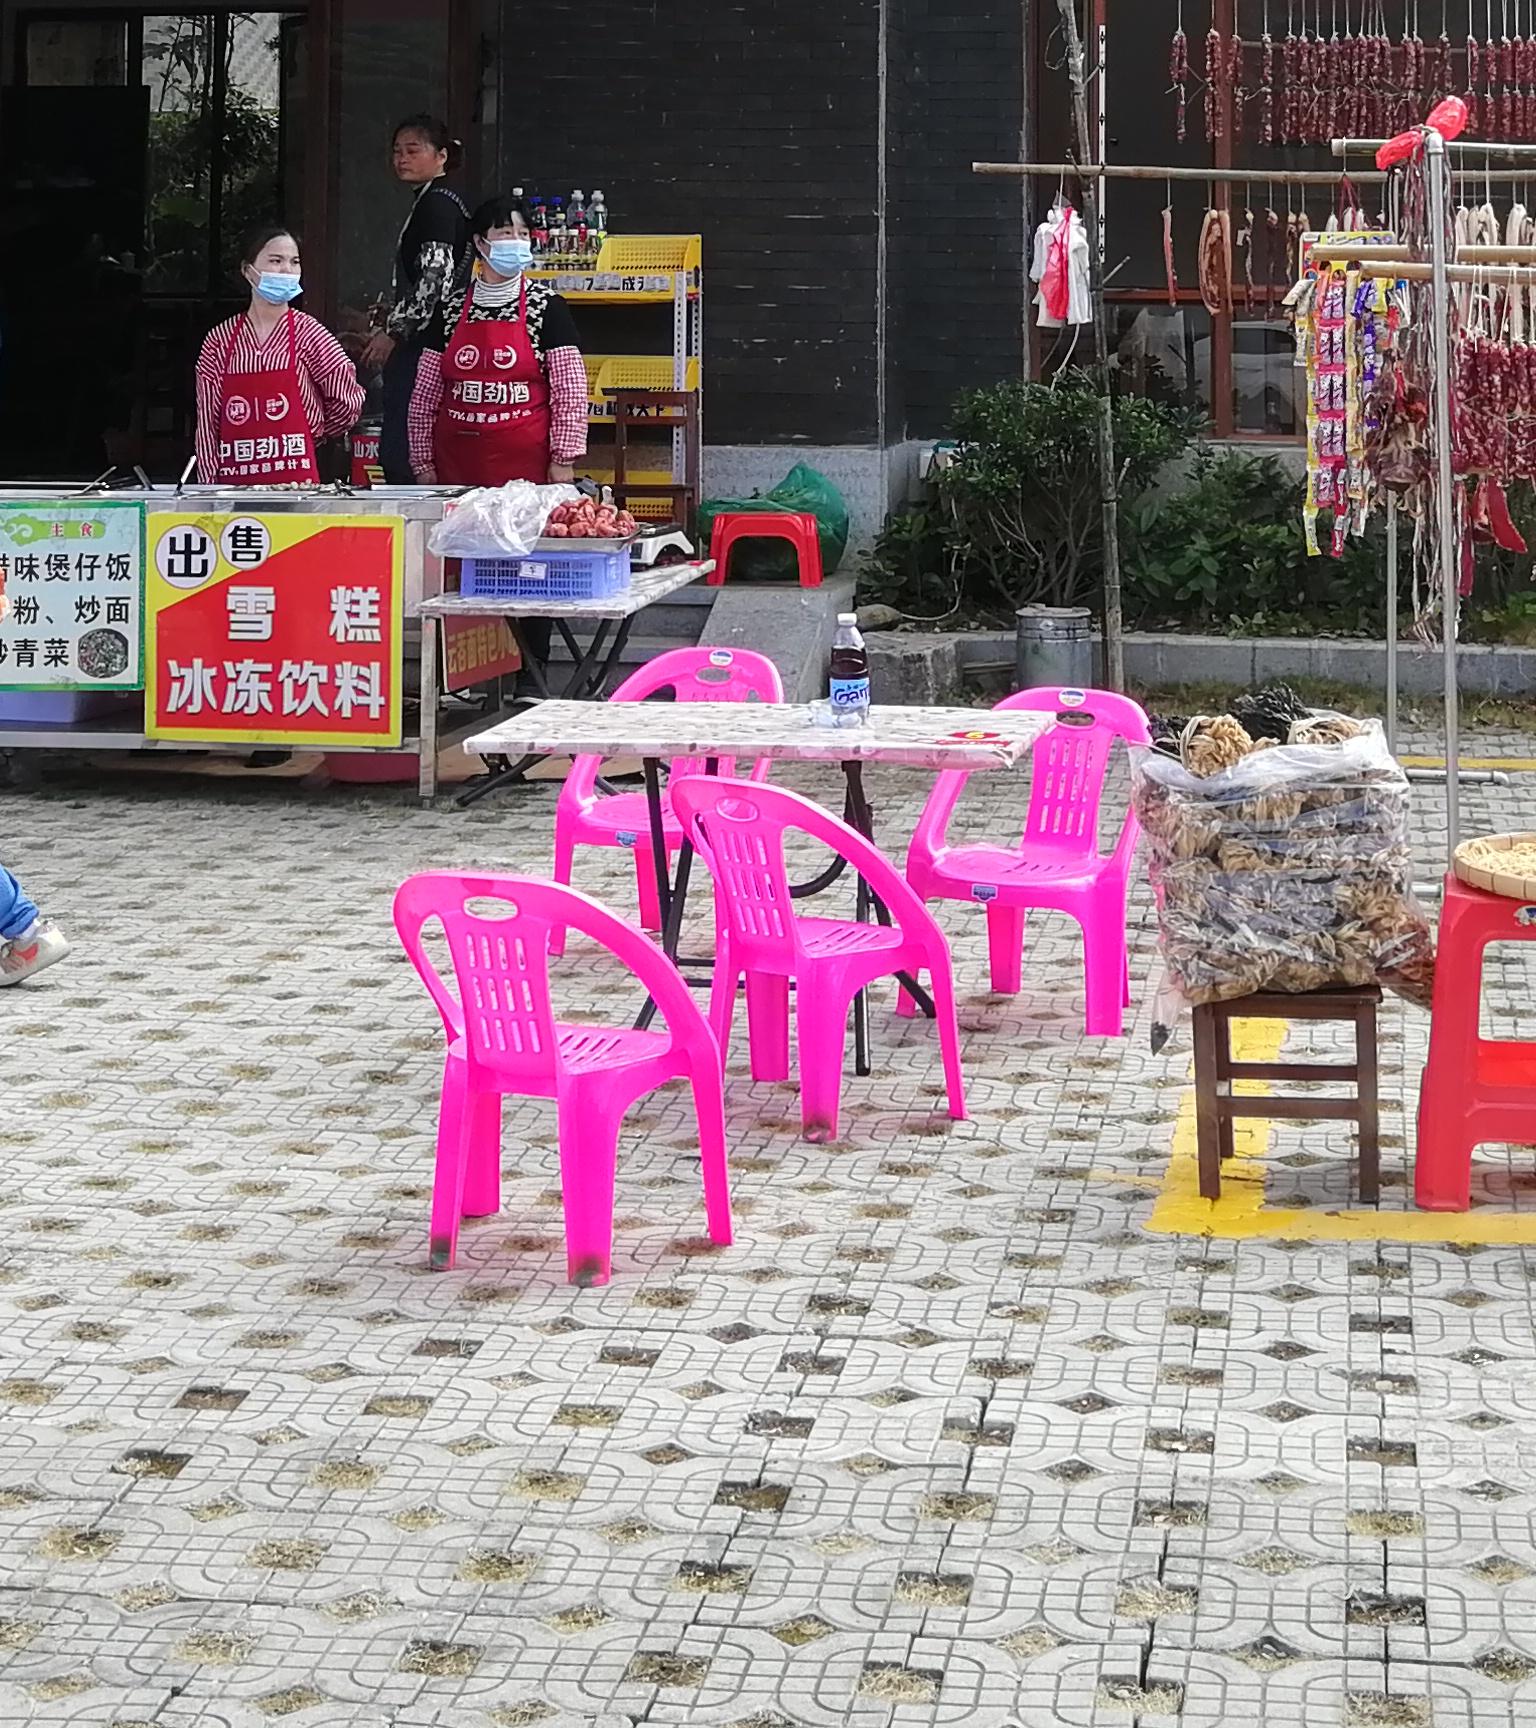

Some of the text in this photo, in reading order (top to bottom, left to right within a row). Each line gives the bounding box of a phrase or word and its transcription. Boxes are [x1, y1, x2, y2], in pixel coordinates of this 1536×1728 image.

[219, 433, 307, 464] 中国劲酒
[51, 522, 93, 538] 主食
[167, 524, 264, 578] 出售
[226, 585, 382, 643] 雪糕
[166, 658, 386, 720] 冰冻饮料
